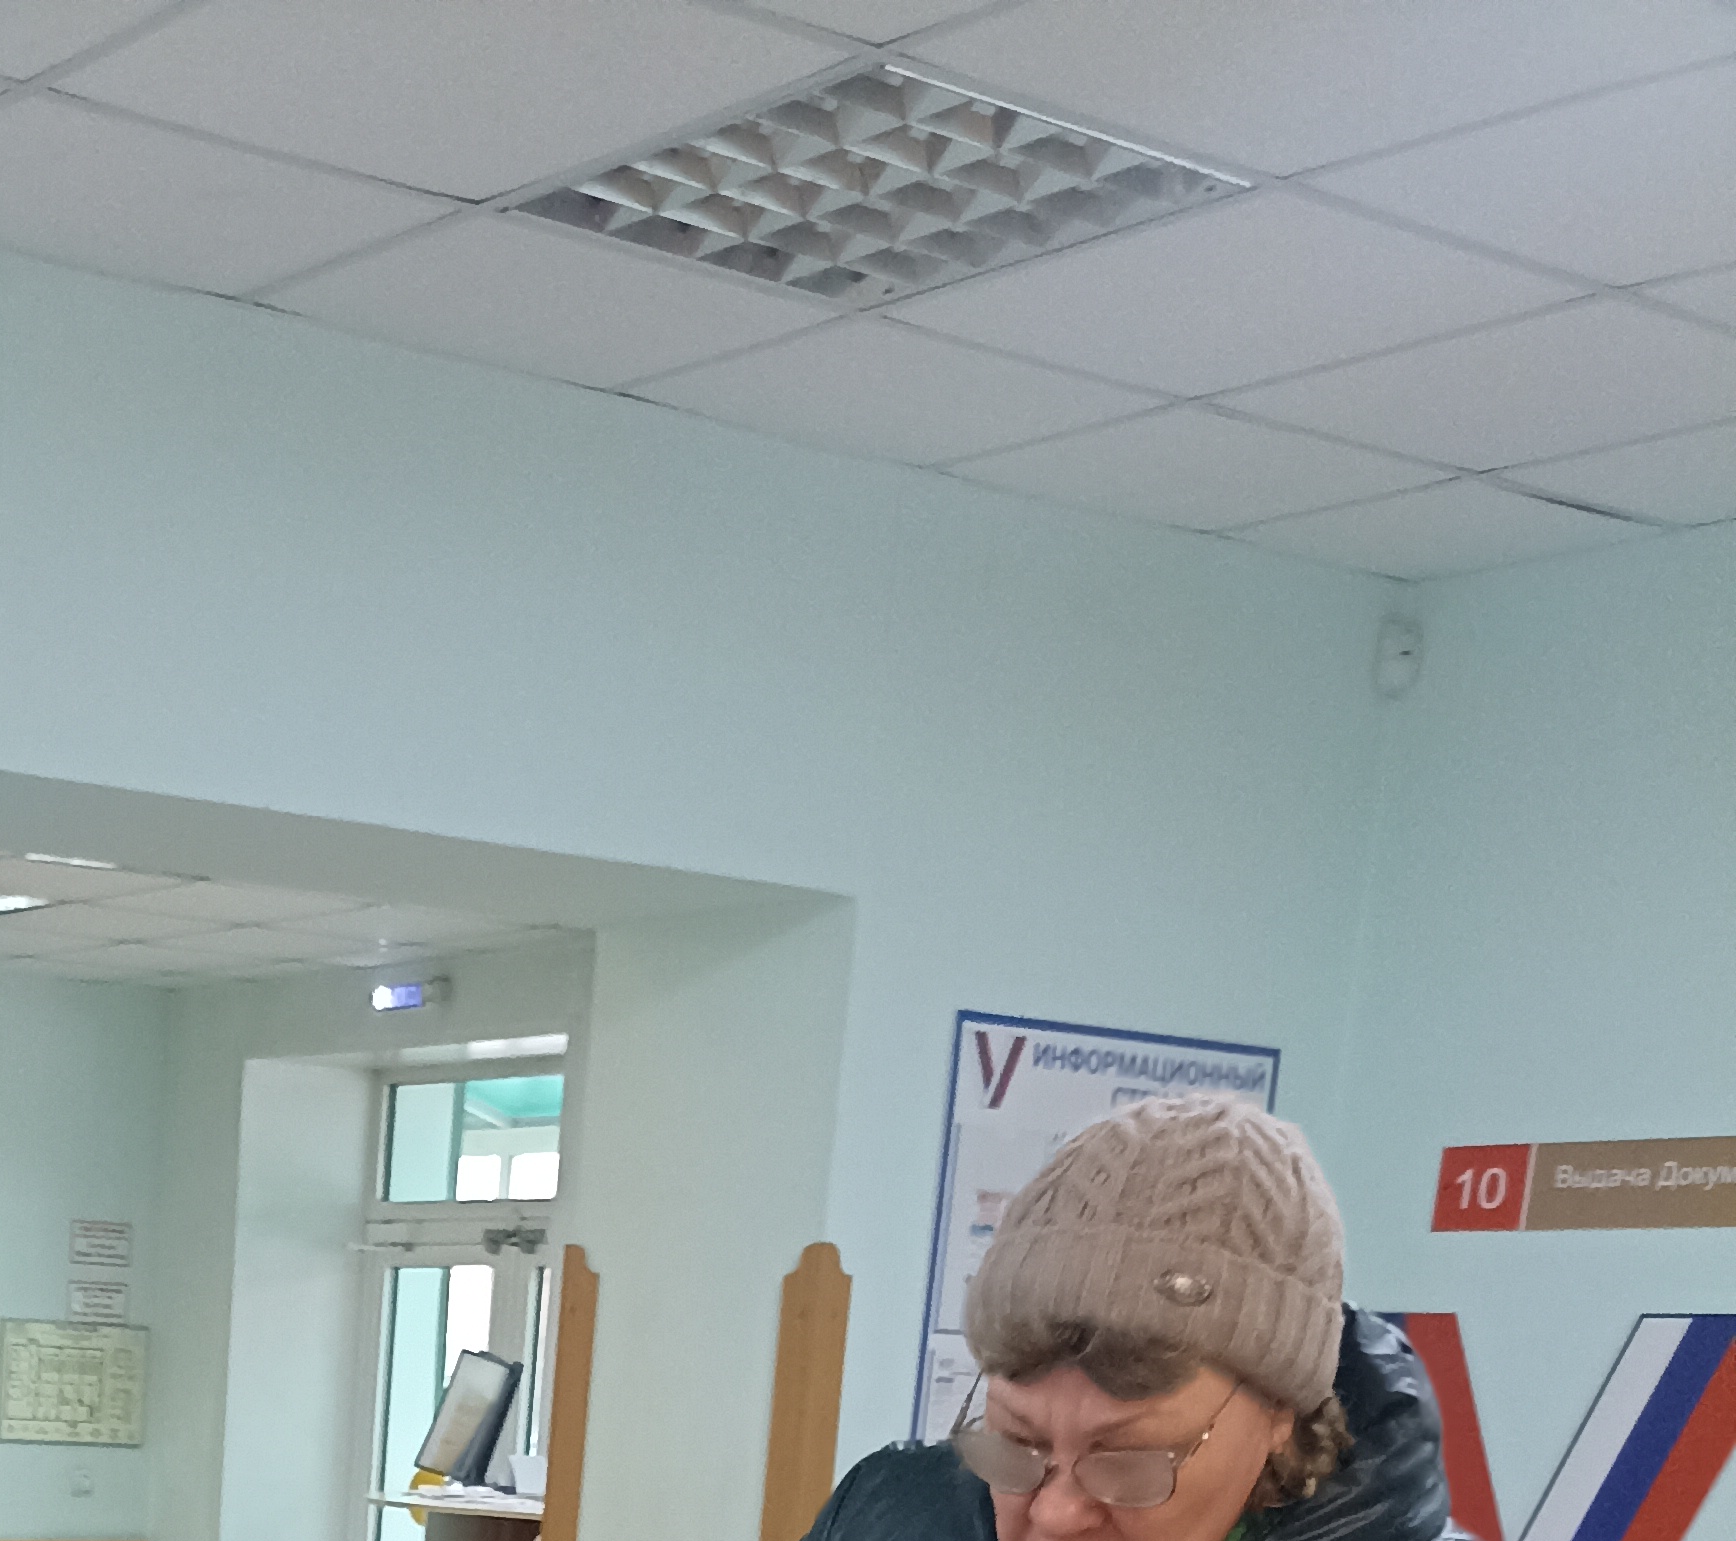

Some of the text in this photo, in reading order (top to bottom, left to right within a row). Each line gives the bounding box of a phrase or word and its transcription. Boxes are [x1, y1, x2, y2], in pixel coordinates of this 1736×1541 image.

[1033, 1042, 1266, 1090] ИНФОРМАЦИОННЫЙ
[1455, 1167, 1508, 1210] 10
[1553, 1164, 1653, 1189] Выдача
